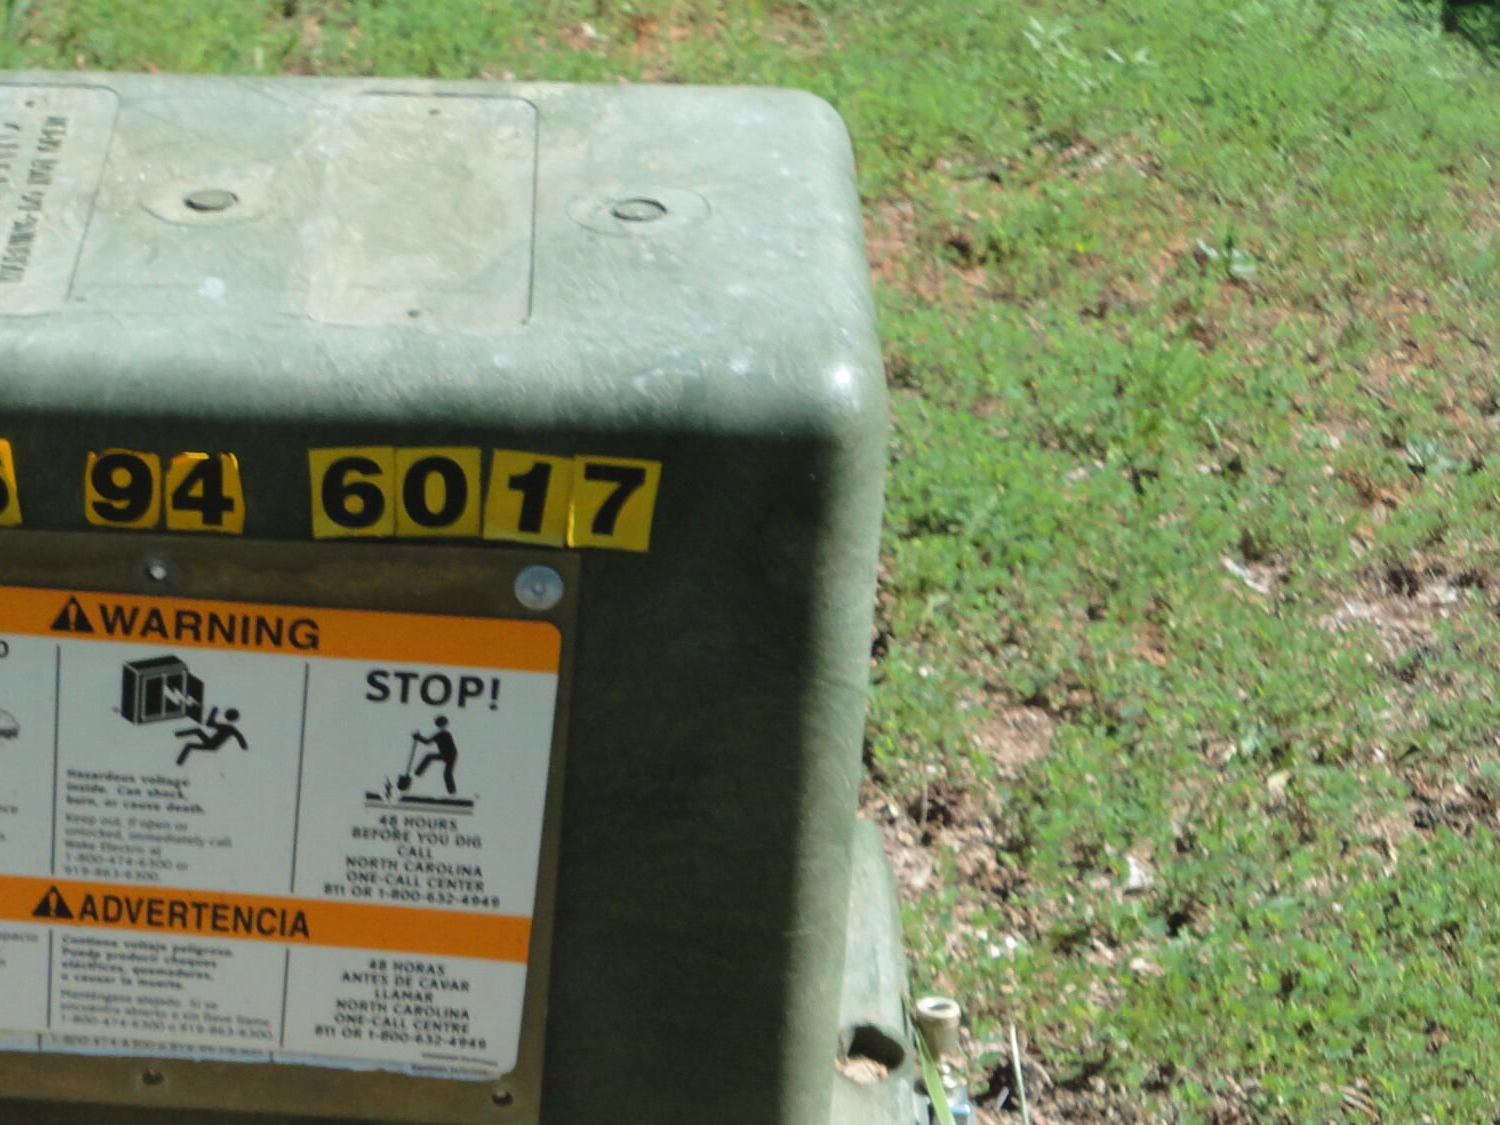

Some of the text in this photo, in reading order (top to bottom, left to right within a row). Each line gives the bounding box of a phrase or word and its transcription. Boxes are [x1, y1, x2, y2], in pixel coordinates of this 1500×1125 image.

[89, 452, 236, 526] 94
[319, 456, 647, 538] 6017
[100, 604, 319, 650] WARNING
[366, 669, 501, 711] STOP!
[67, 770, 189, 789] Hazardous voltage
[380, 815, 458, 832] 48 HOURS
[352, 826, 482, 848] BEFORE YOU DIG
[397, 845, 432, 858] CALL
[346, 856, 482, 877] NORTH CAROLINA
[324, 883, 345, 895] 811
[351, 886, 372, 896] OR
[427, 877, 484, 891] CENTER
[80, 894, 311, 938] ADVERTENCIA
[369, 959, 445, 975] 48 HORAS
[341, 972, 470, 992] ANTES DE CAVAR
[374, 988, 434, 1002] LLAMAR
[336, 999, 469, 1020] NORTH CAROLINA
[342, 1027, 362, 1039] OR
[413, 1021, 468, 1034] CENTRE
